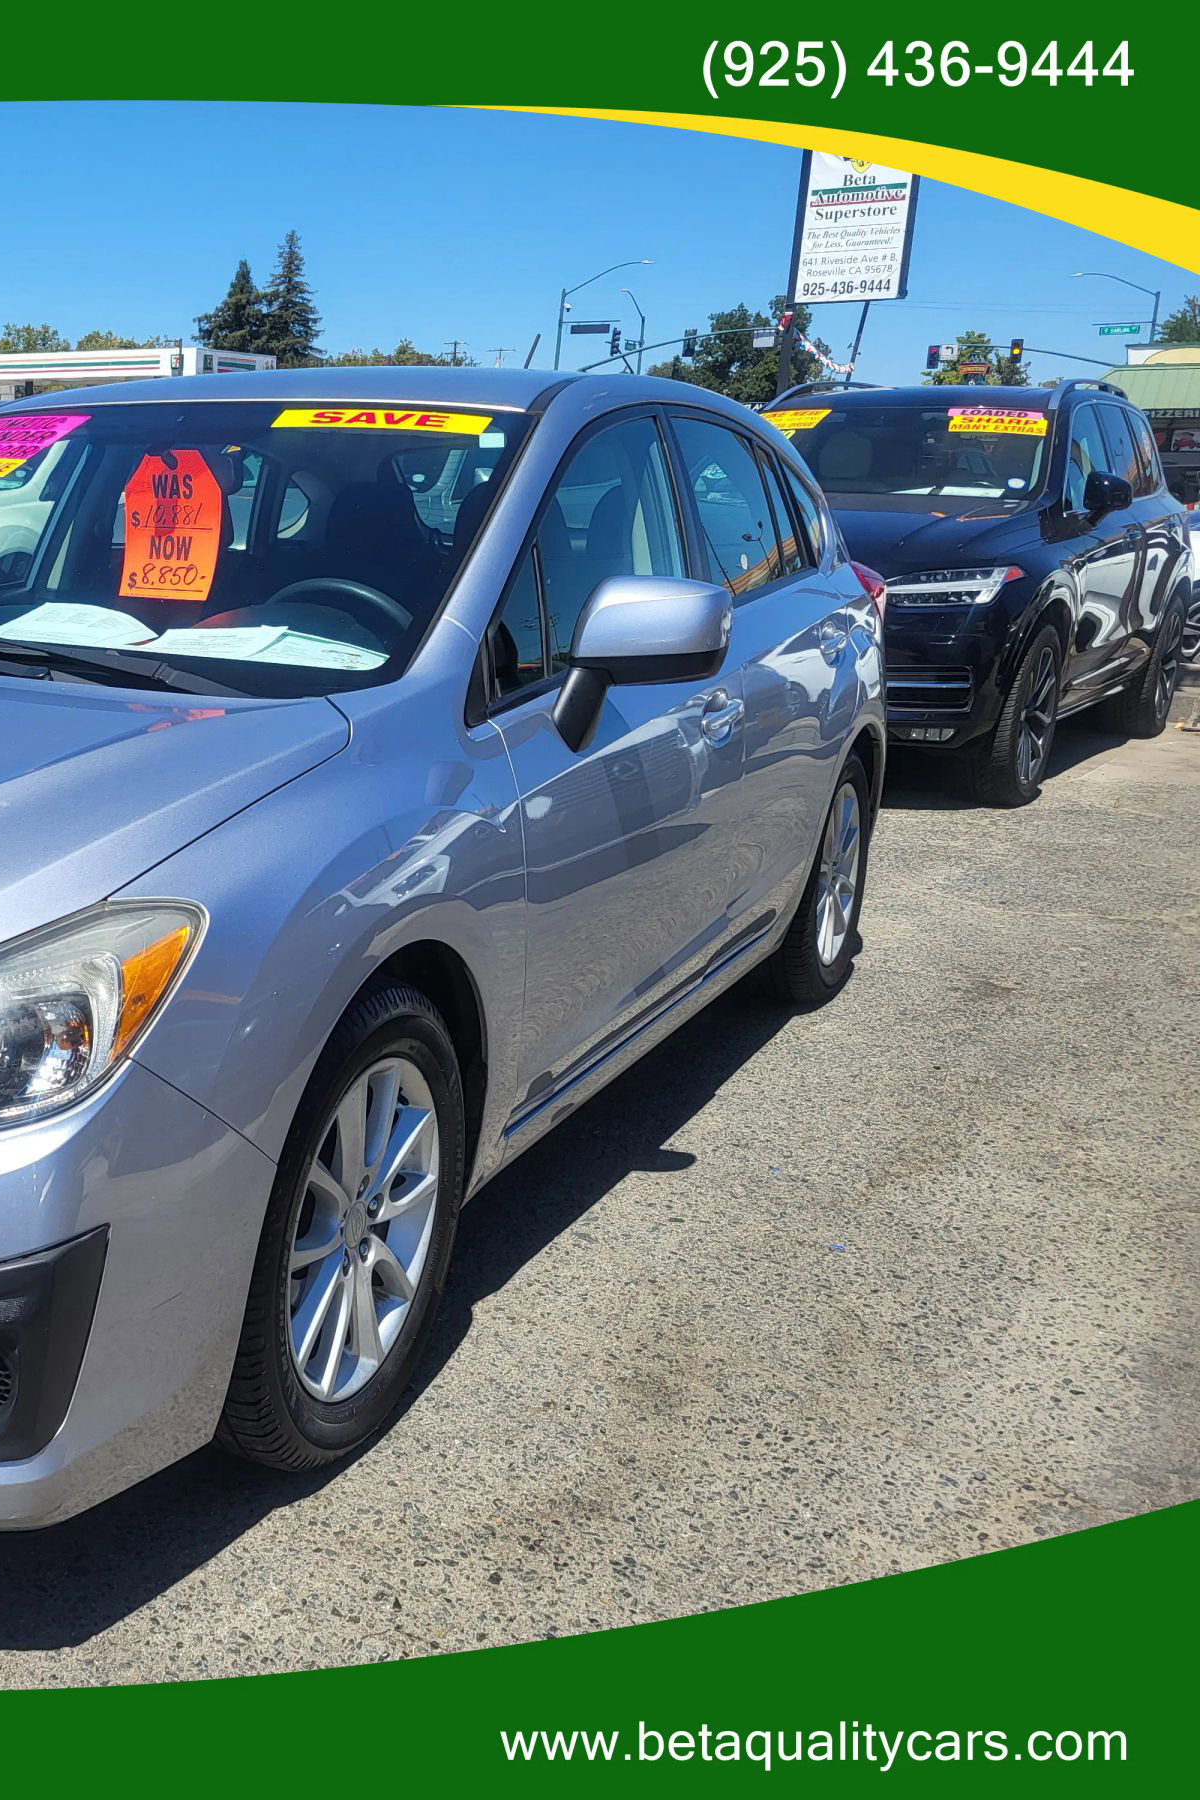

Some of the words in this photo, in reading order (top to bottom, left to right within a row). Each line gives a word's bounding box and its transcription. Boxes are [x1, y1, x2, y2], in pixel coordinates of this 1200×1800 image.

[843, 174, 876, 187] Beta
[815, 187, 903, 205] Automotive
[814, 206, 898, 223] Superstore
[807, 231, 822, 240] The
[823, 230, 839, 239] Best
[840, 228, 868, 240] Quality
[870, 226, 901, 236] Vehicles
[811, 241, 823, 252] for
[845, 236, 894, 248] Guaranteed!
[802, 257, 818, 267] 641
[821, 254, 858, 266] Riveside
[860, 254, 879, 263] Ave
[881, 253, 888, 262] #
[806, 265, 846, 277] Roseville
[848, 265, 862, 275] CA
[864, 264, 893, 274] 95678
[802, 278, 891, 296] 925-436-9444
[309, 411, 451, 428] SAVE
[960, 409, 1029, 418] LOADED
[960, 417, 1039, 425] SHARP
[993, 425, 1044, 434] EXTRAS
[151, 473, 193, 500] WAS
[149, 535, 193, 561] NOW
